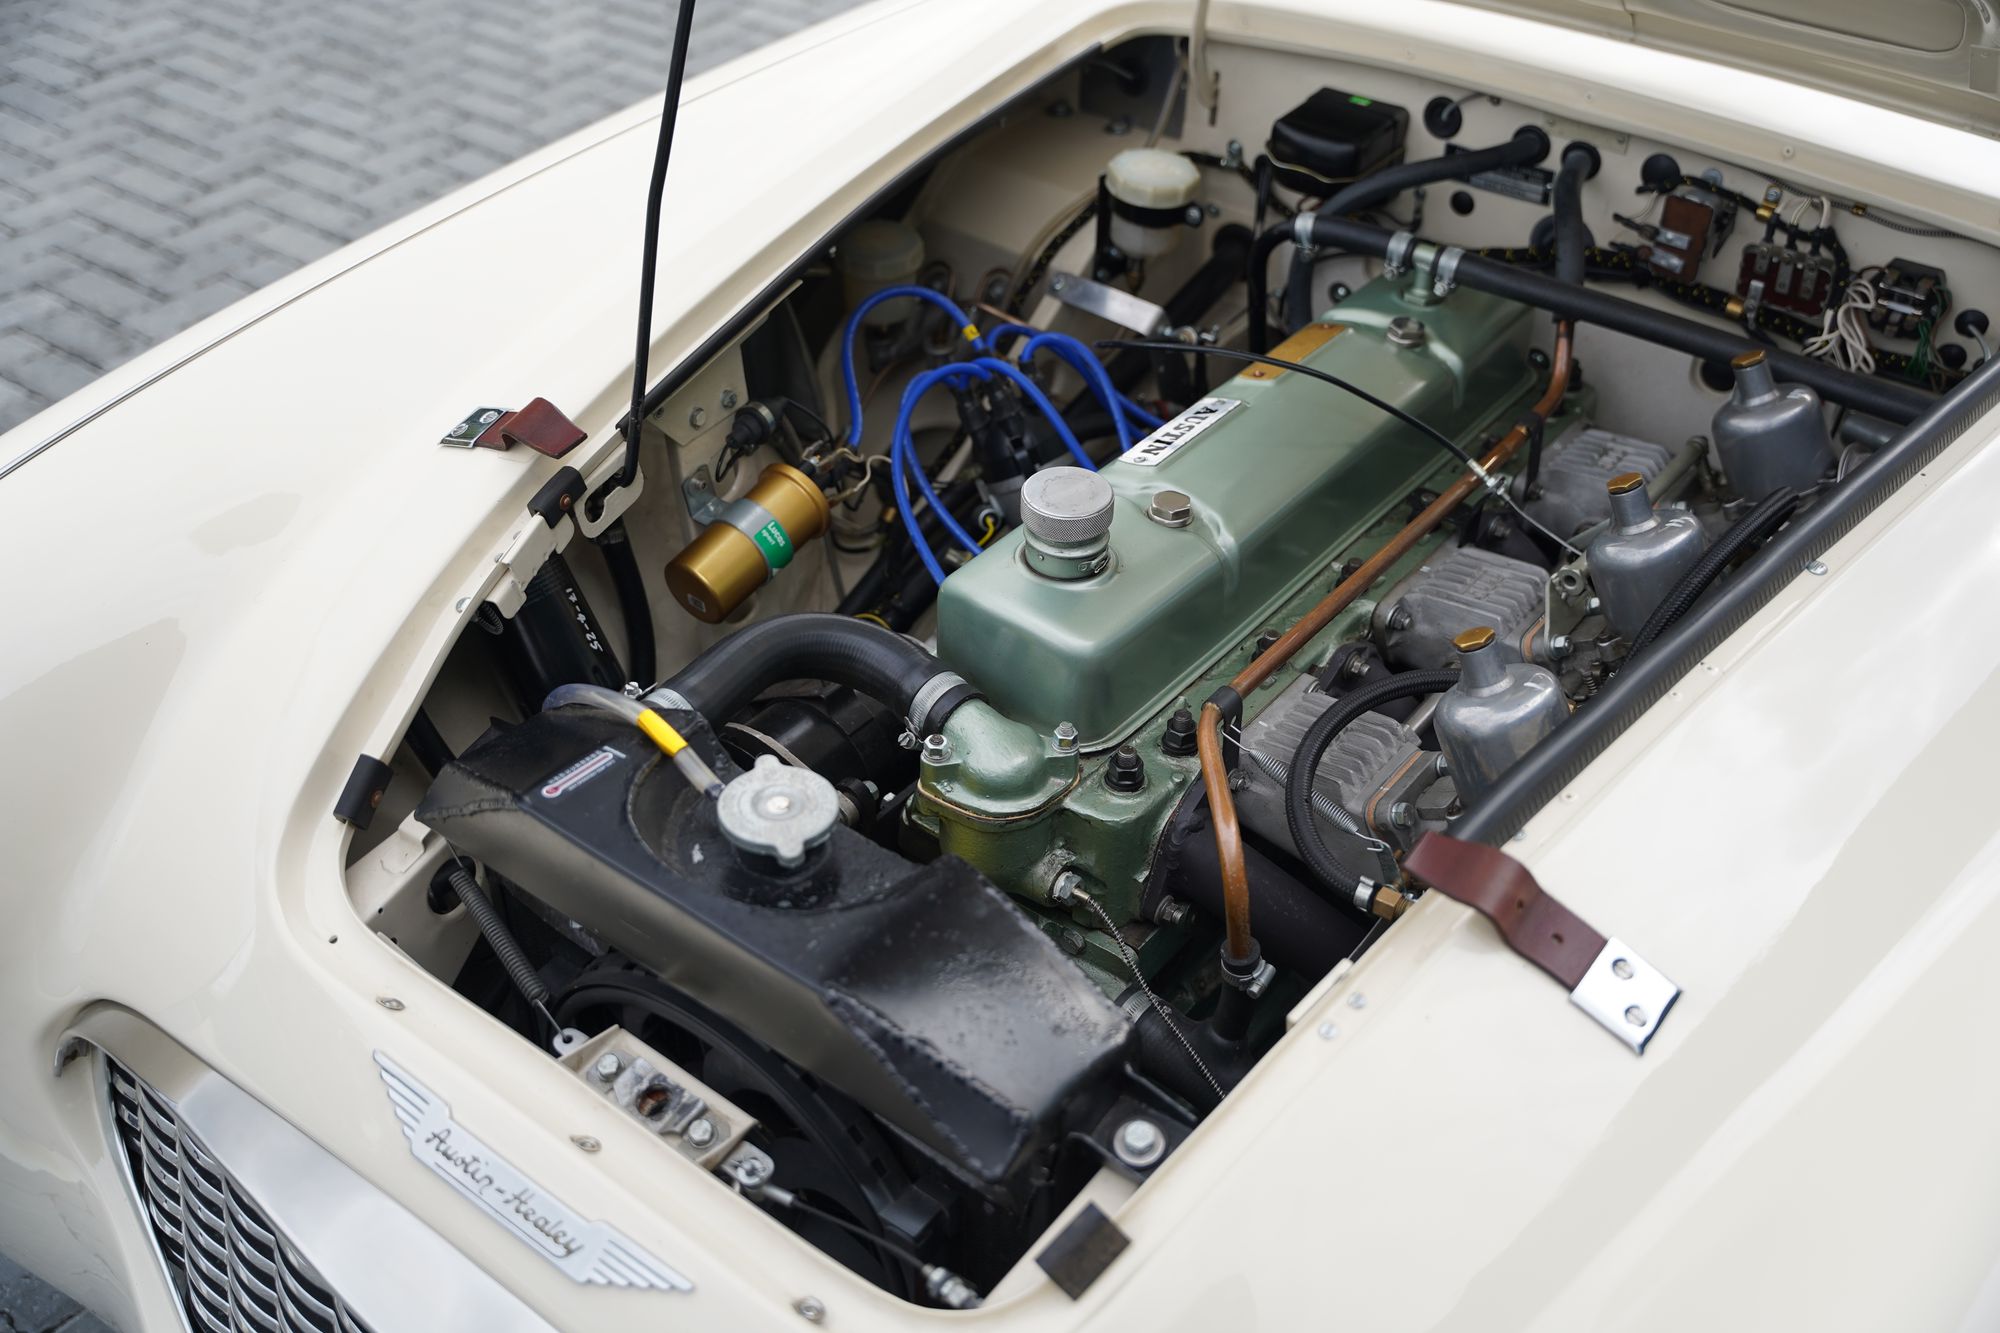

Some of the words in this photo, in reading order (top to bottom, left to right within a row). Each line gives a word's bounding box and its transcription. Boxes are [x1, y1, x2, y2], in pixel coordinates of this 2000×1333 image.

[1140, 406, 1218, 456] AUSTIN
[767, 521, 786, 547] Lucas
[425, 1128, 584, 1258] Austin-Healey
